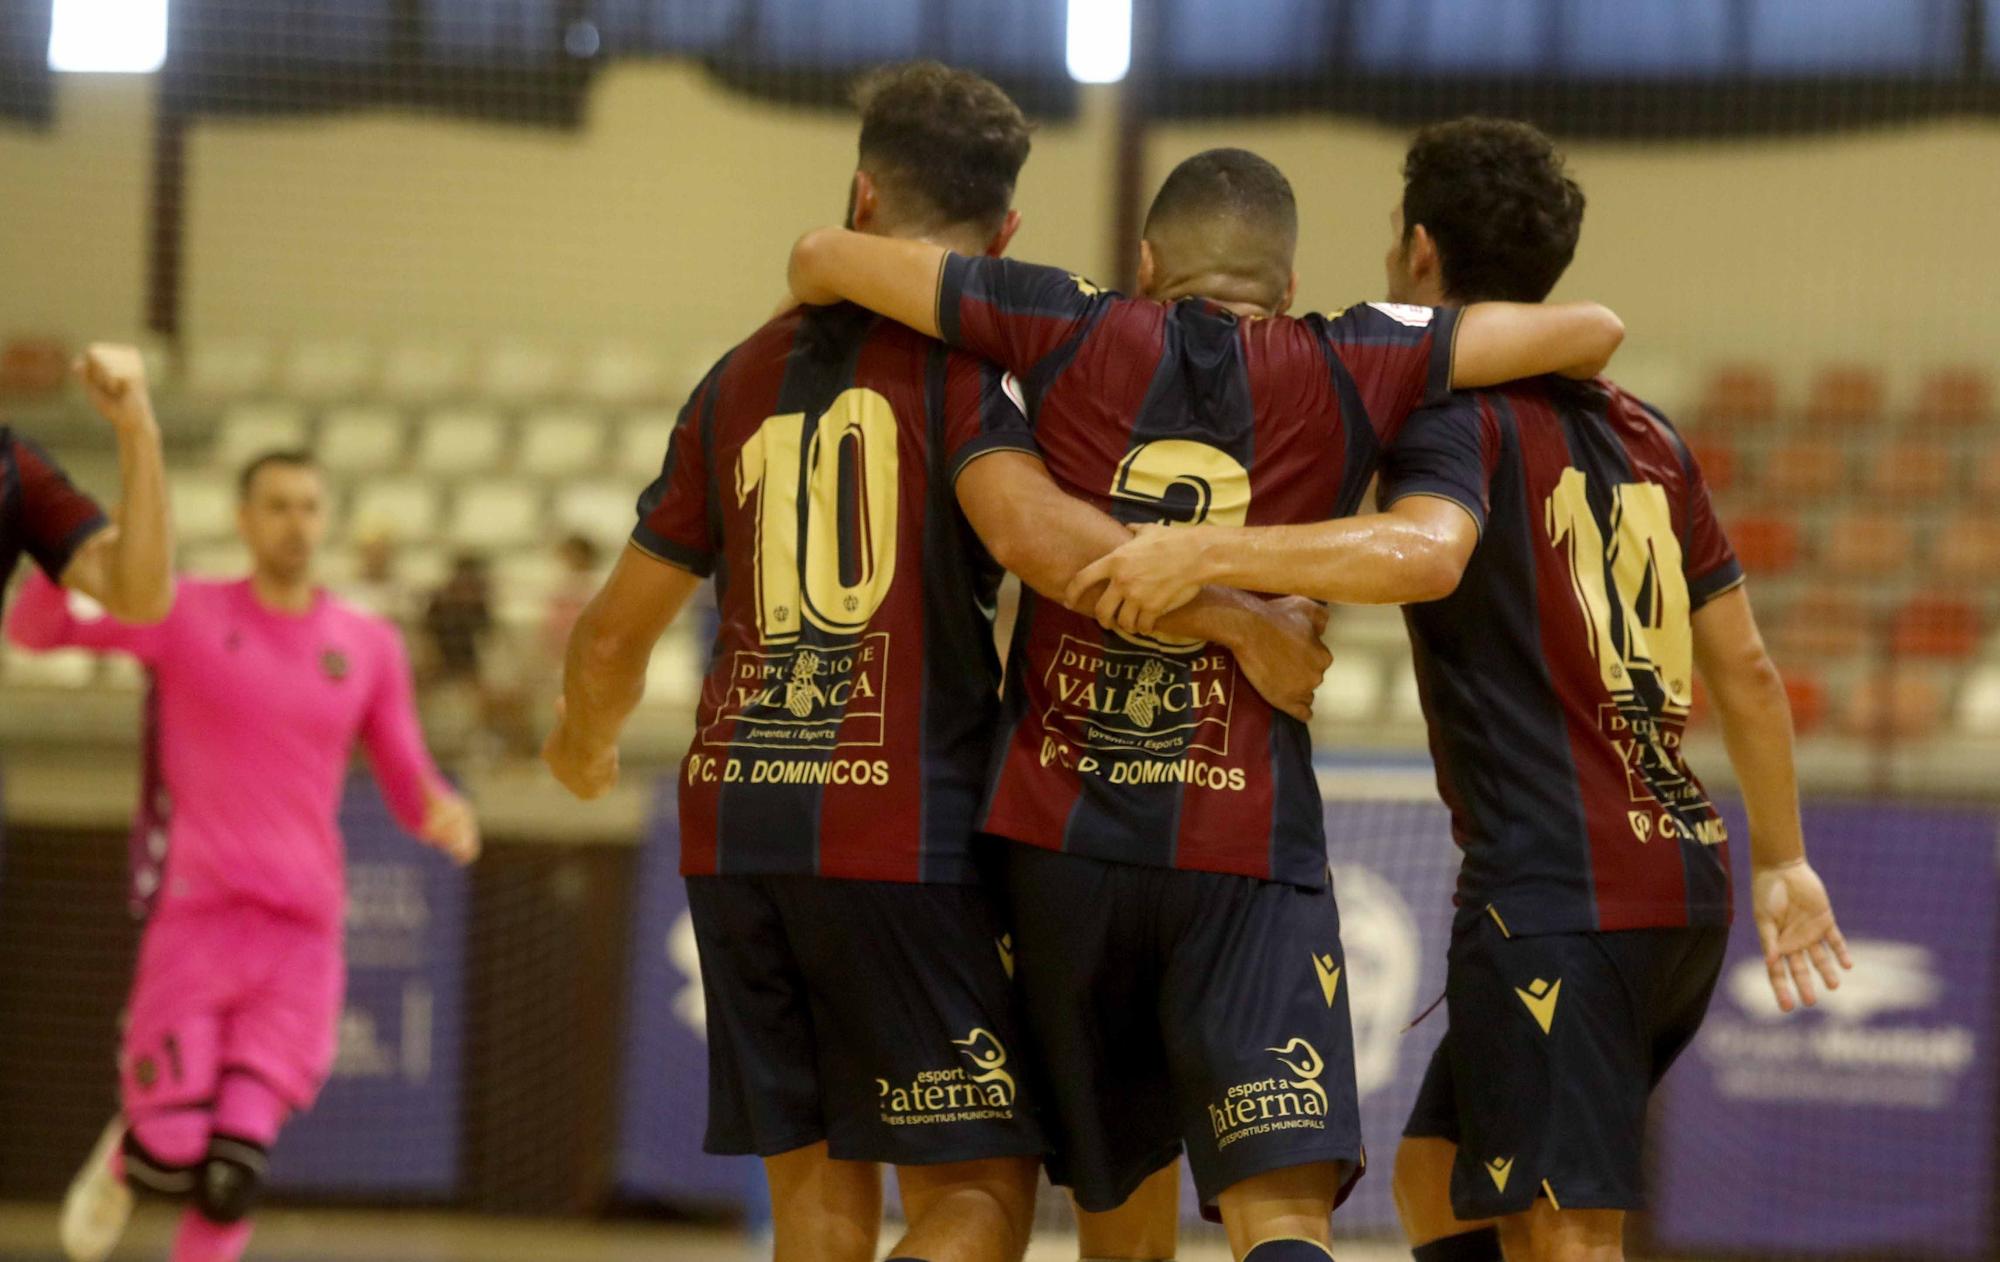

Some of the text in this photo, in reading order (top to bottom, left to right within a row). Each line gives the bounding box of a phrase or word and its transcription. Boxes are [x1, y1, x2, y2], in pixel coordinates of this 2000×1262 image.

[734, 387, 899, 645] 10
[1545, 466, 1693, 714] 14
[1190, 655, 1227, 672] DE
[702, 758, 889, 786] C. D. DOMINICOS
[1077, 756, 1102, 776] D.
[1108, 758, 1247, 791] DOMINICOS
[917, 1067, 965, 1084] esport
[1227, 1078, 1289, 1098] esport a
